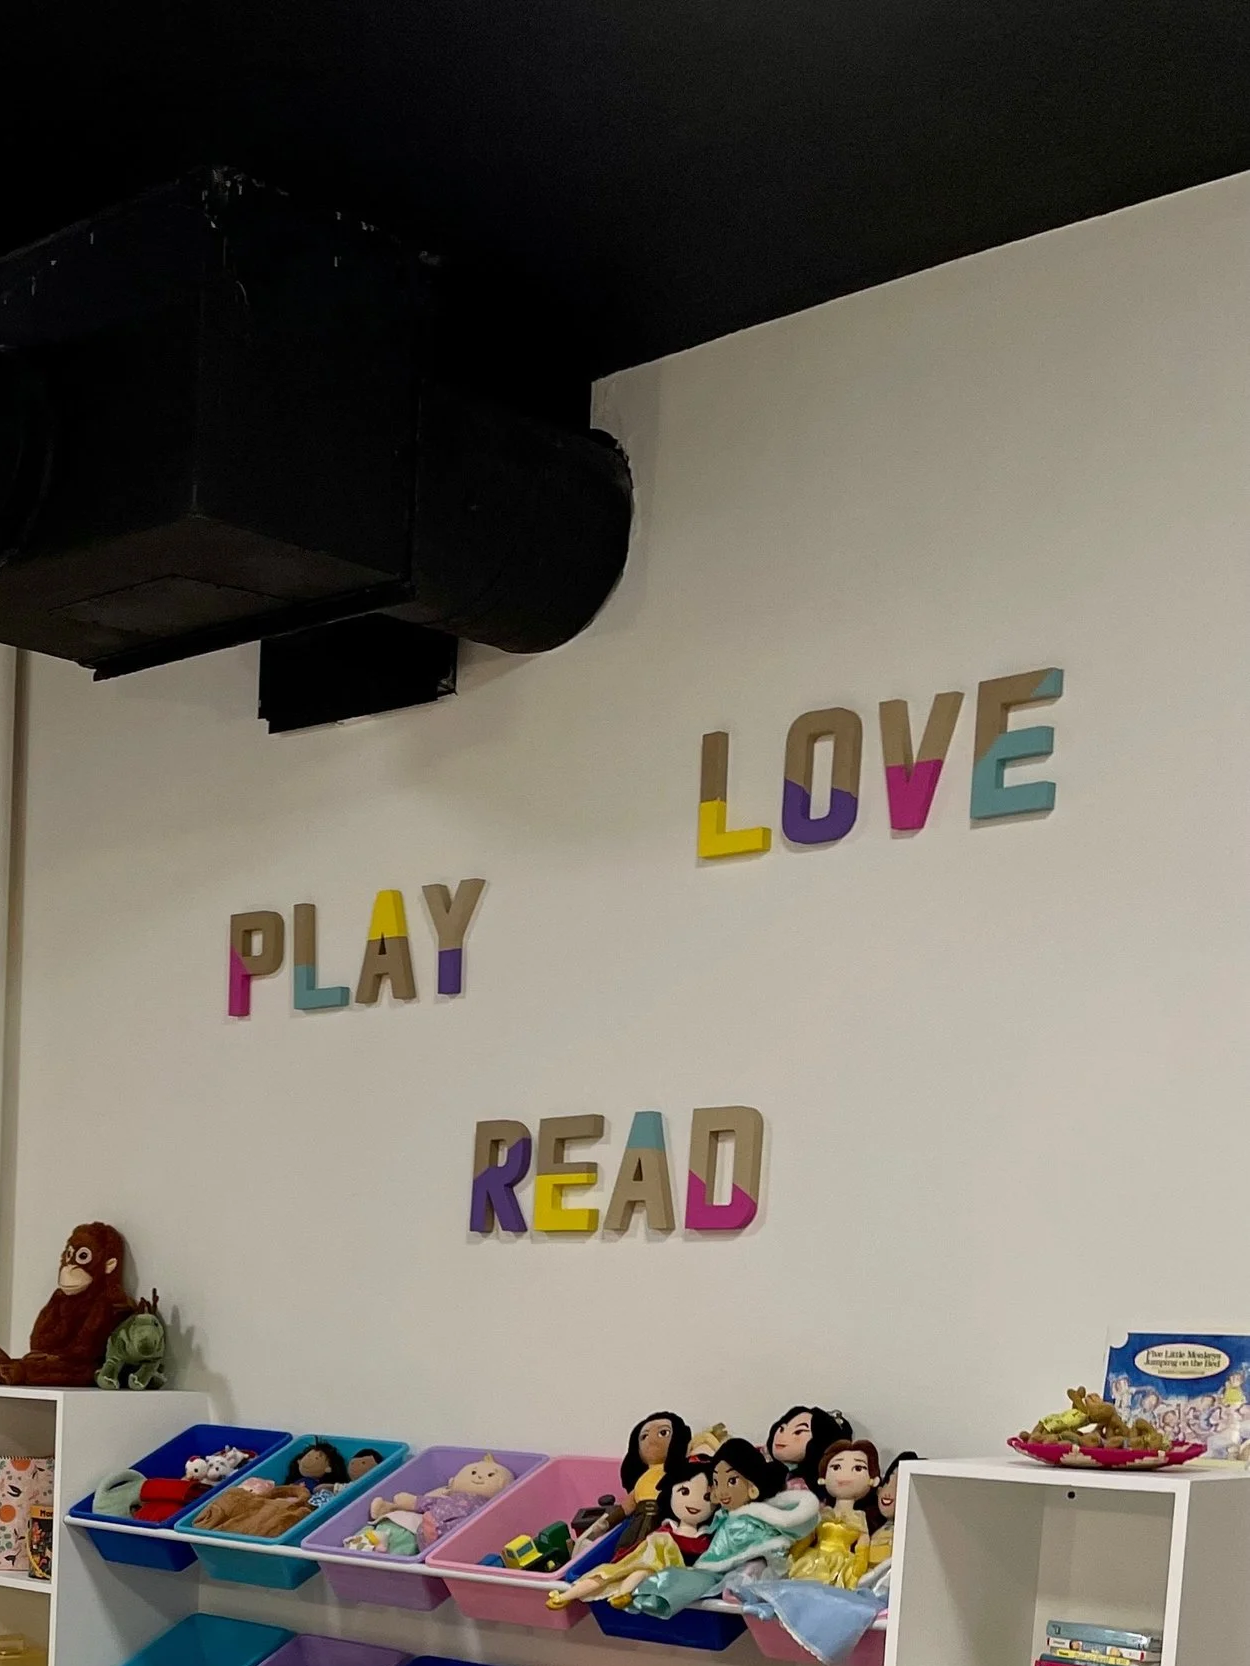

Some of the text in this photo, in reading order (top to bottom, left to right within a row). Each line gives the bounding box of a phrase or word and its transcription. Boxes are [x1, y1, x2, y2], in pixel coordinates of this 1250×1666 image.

[698, 667, 1064, 858] LOVE
[228, 878, 486, 1017] PLAY
[469, 1105, 765, 1234] READ
[1144, 1359, 1178, 1368] Jumping
[1190, 1360, 1204, 1368] the
[1165, 1350, 1185, 1359] Little
[1187, 1351, 1221, 1361] Monkeys
